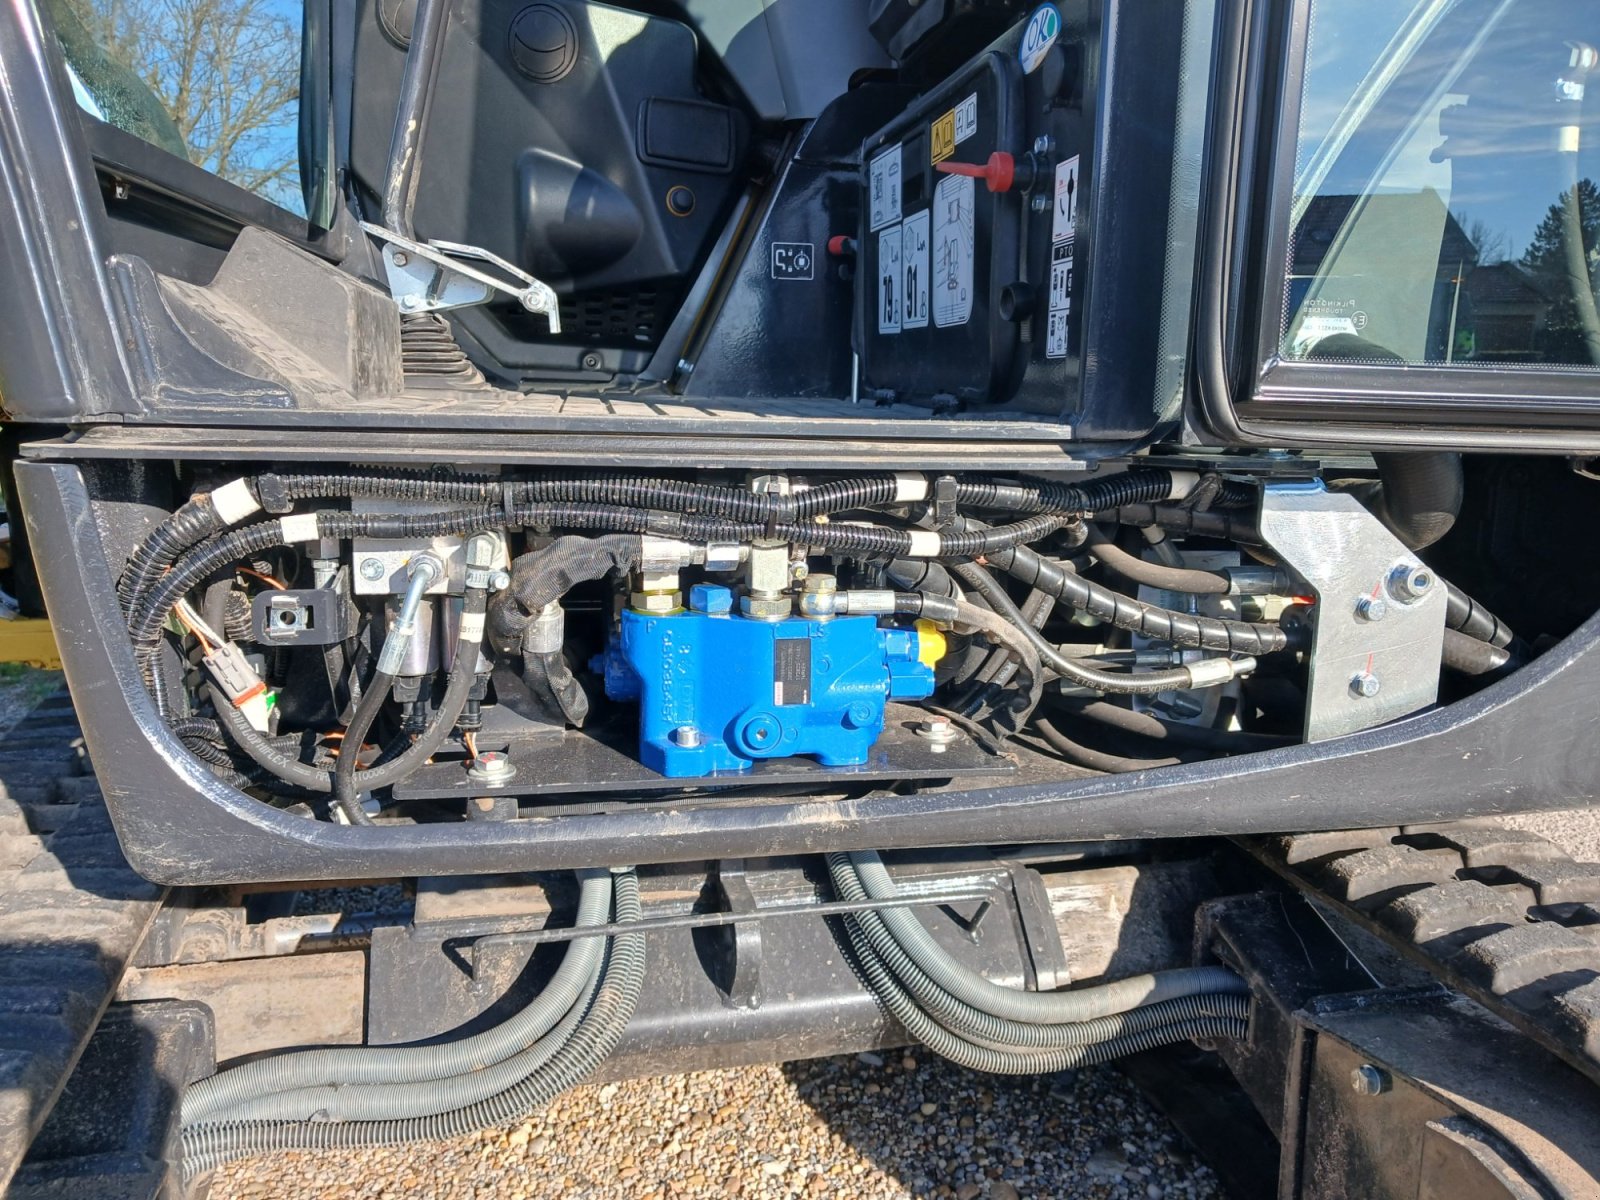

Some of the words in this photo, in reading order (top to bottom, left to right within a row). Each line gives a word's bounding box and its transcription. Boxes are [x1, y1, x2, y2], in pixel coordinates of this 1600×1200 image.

[1028, 9, 1049, 52] OK
[1059, 245, 1073, 259] PTO
[882, 274, 893, 324] 79
[906, 263, 918, 319] 91
